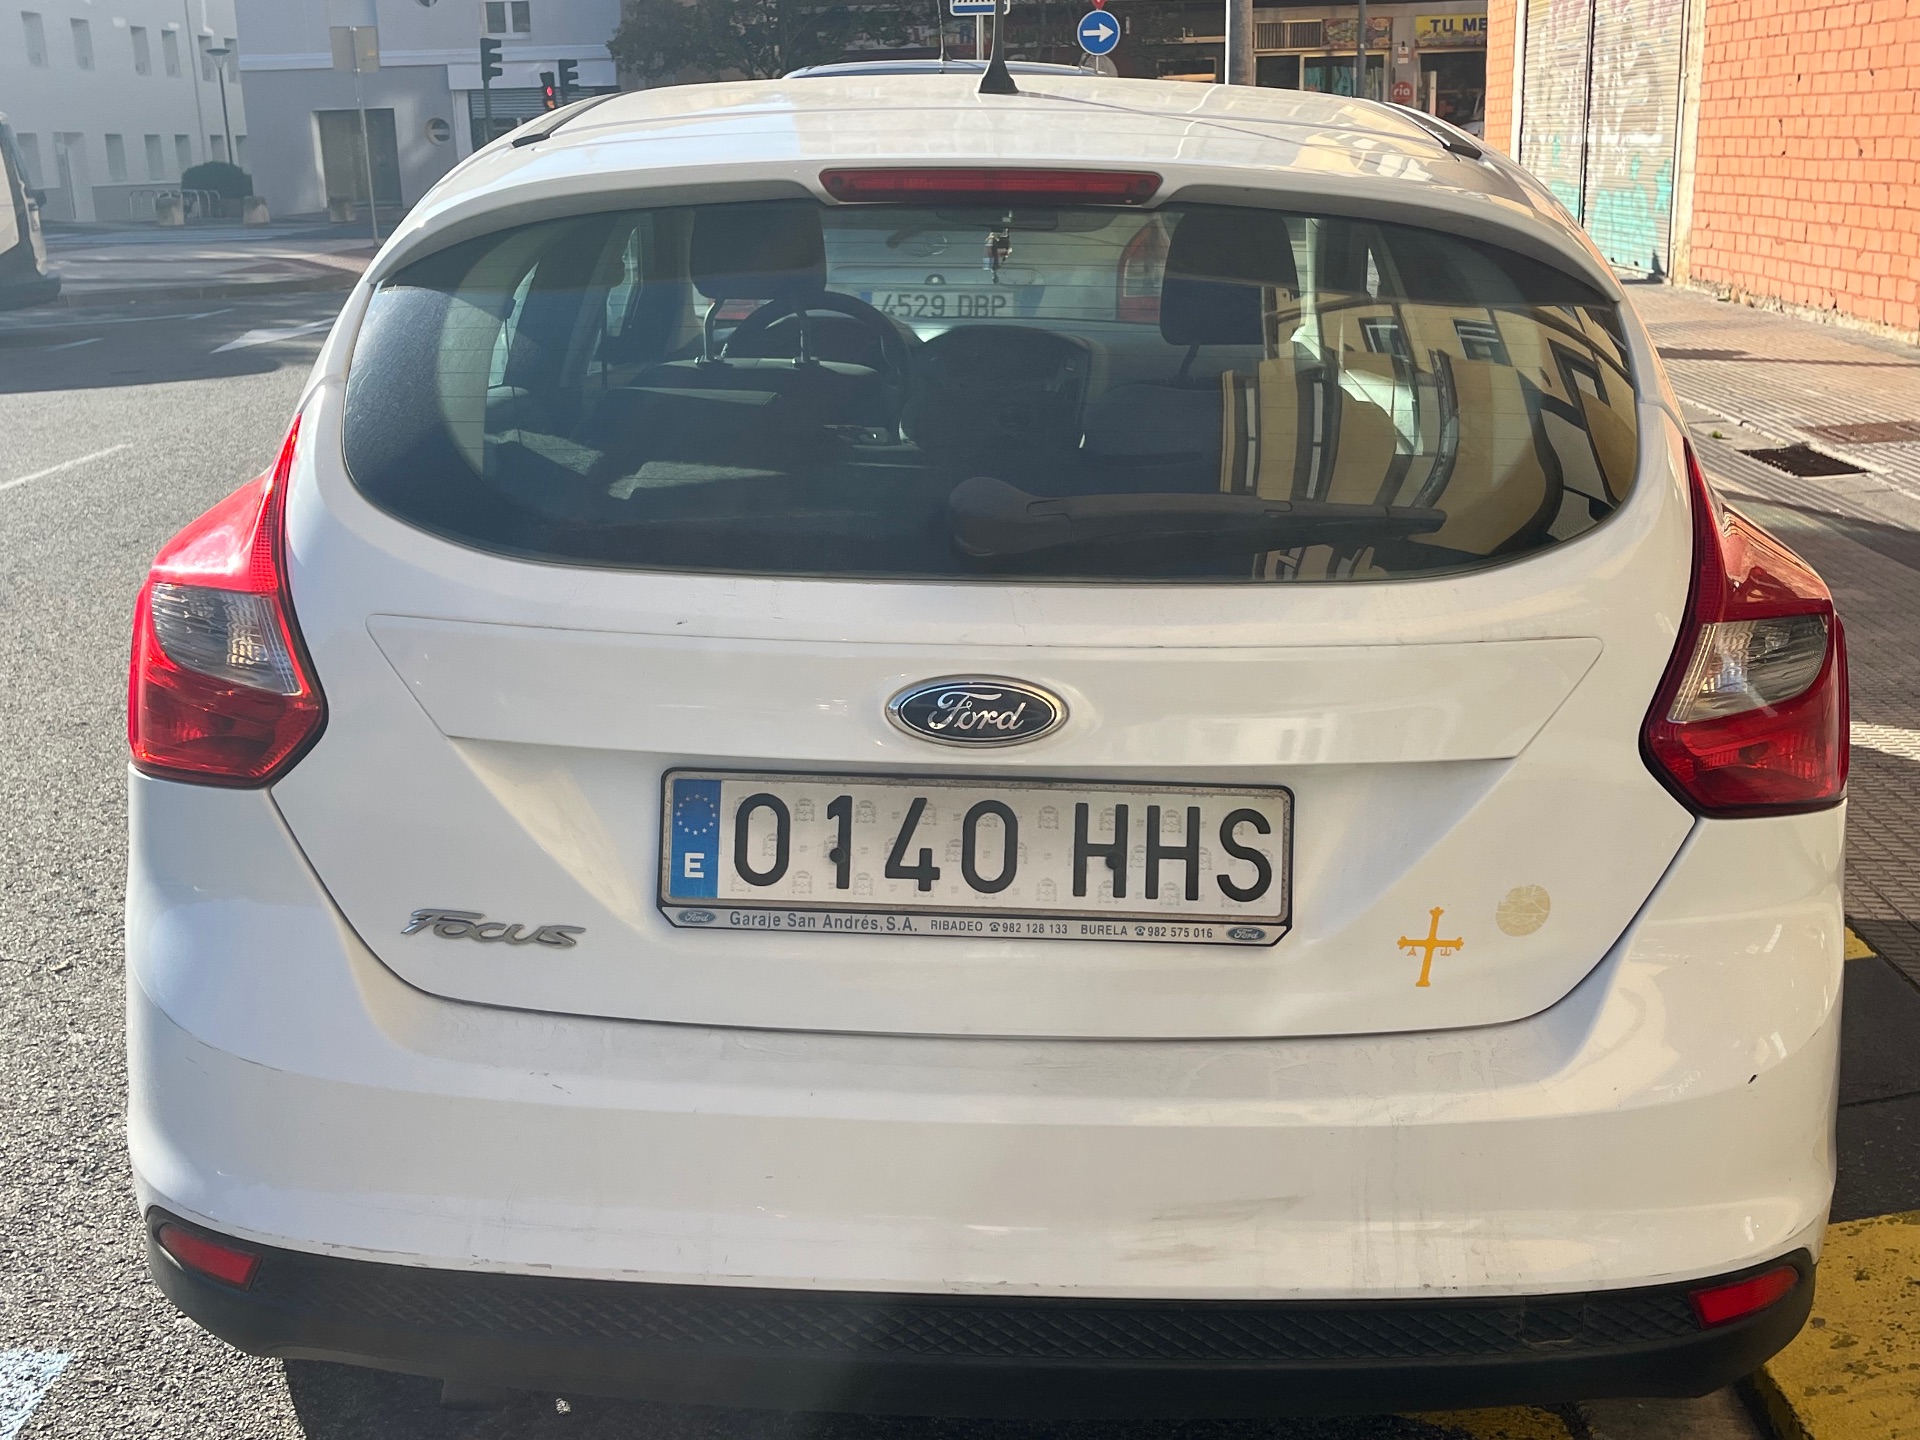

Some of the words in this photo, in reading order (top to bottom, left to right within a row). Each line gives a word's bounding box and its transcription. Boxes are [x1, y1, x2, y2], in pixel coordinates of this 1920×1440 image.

[1430, 19, 1453, 32] TU
[1393, 84, 1411, 96] ria
[881, 293, 945, 318] 4529
[957, 294, 1007, 318] DBP
[927, 691, 1027, 731] Ford
[734, 792, 1018, 894] 0140
[1073, 802, 1272, 902] HHS
[684, 852, 705, 879] E
[401, 909, 586, 947] Focus
[683, 911, 708, 923] Ford
[729, 910, 782, 929] Garaje
[786, 913, 817, 929] San
[885, 916, 918, 932] S.A.
[930, 920, 983, 932] RIBADEO
[1026, 923, 1045, 935] 128
[1049, 924, 1069, 936] 133
[1080, 924, 1128, 936] BURELA
[1171, 927, 1190, 939] 575
[1193, 928, 1213, 940] 016
[1233, 928, 1260, 941] Ford
